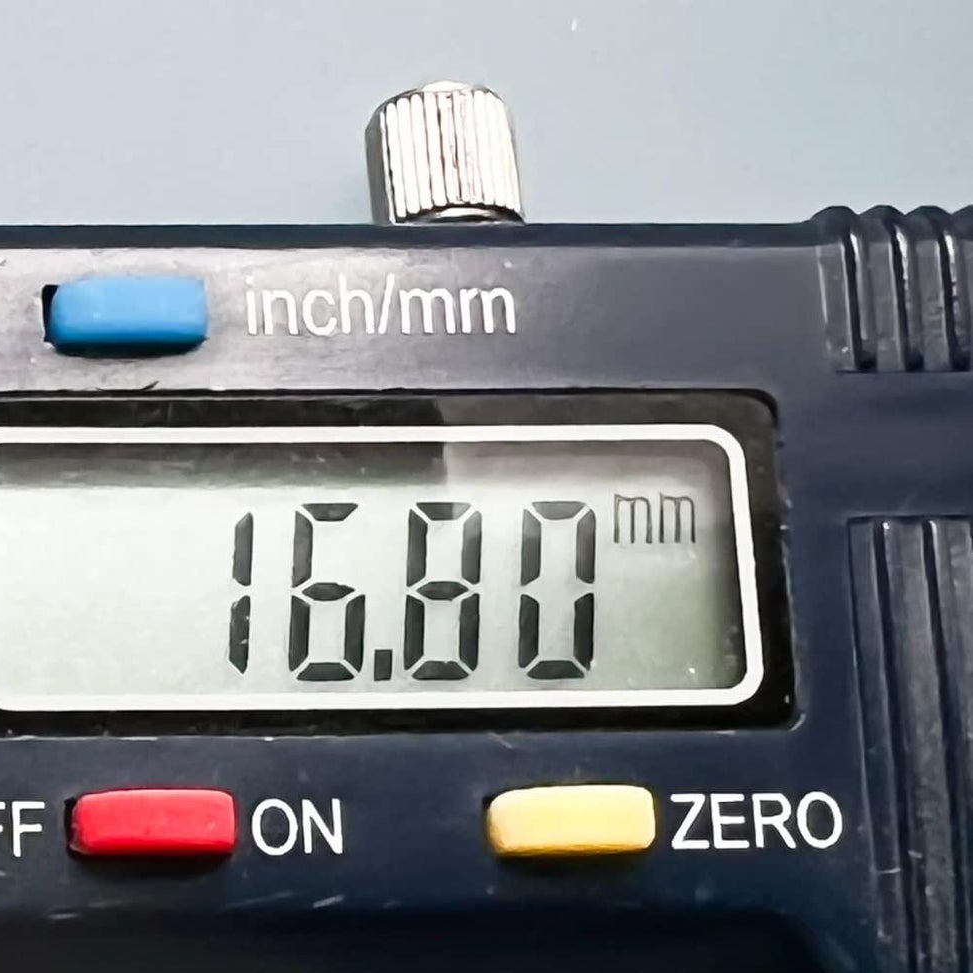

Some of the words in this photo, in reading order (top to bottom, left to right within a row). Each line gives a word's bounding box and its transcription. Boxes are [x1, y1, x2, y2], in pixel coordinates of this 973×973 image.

[245, 274, 517, 336] inch/mm
[228, 501, 596, 683] 16.80
[613, 492, 697, 544] mm
[251, 798, 344, 855] ON
[671, 792, 844, 850] ZERO
